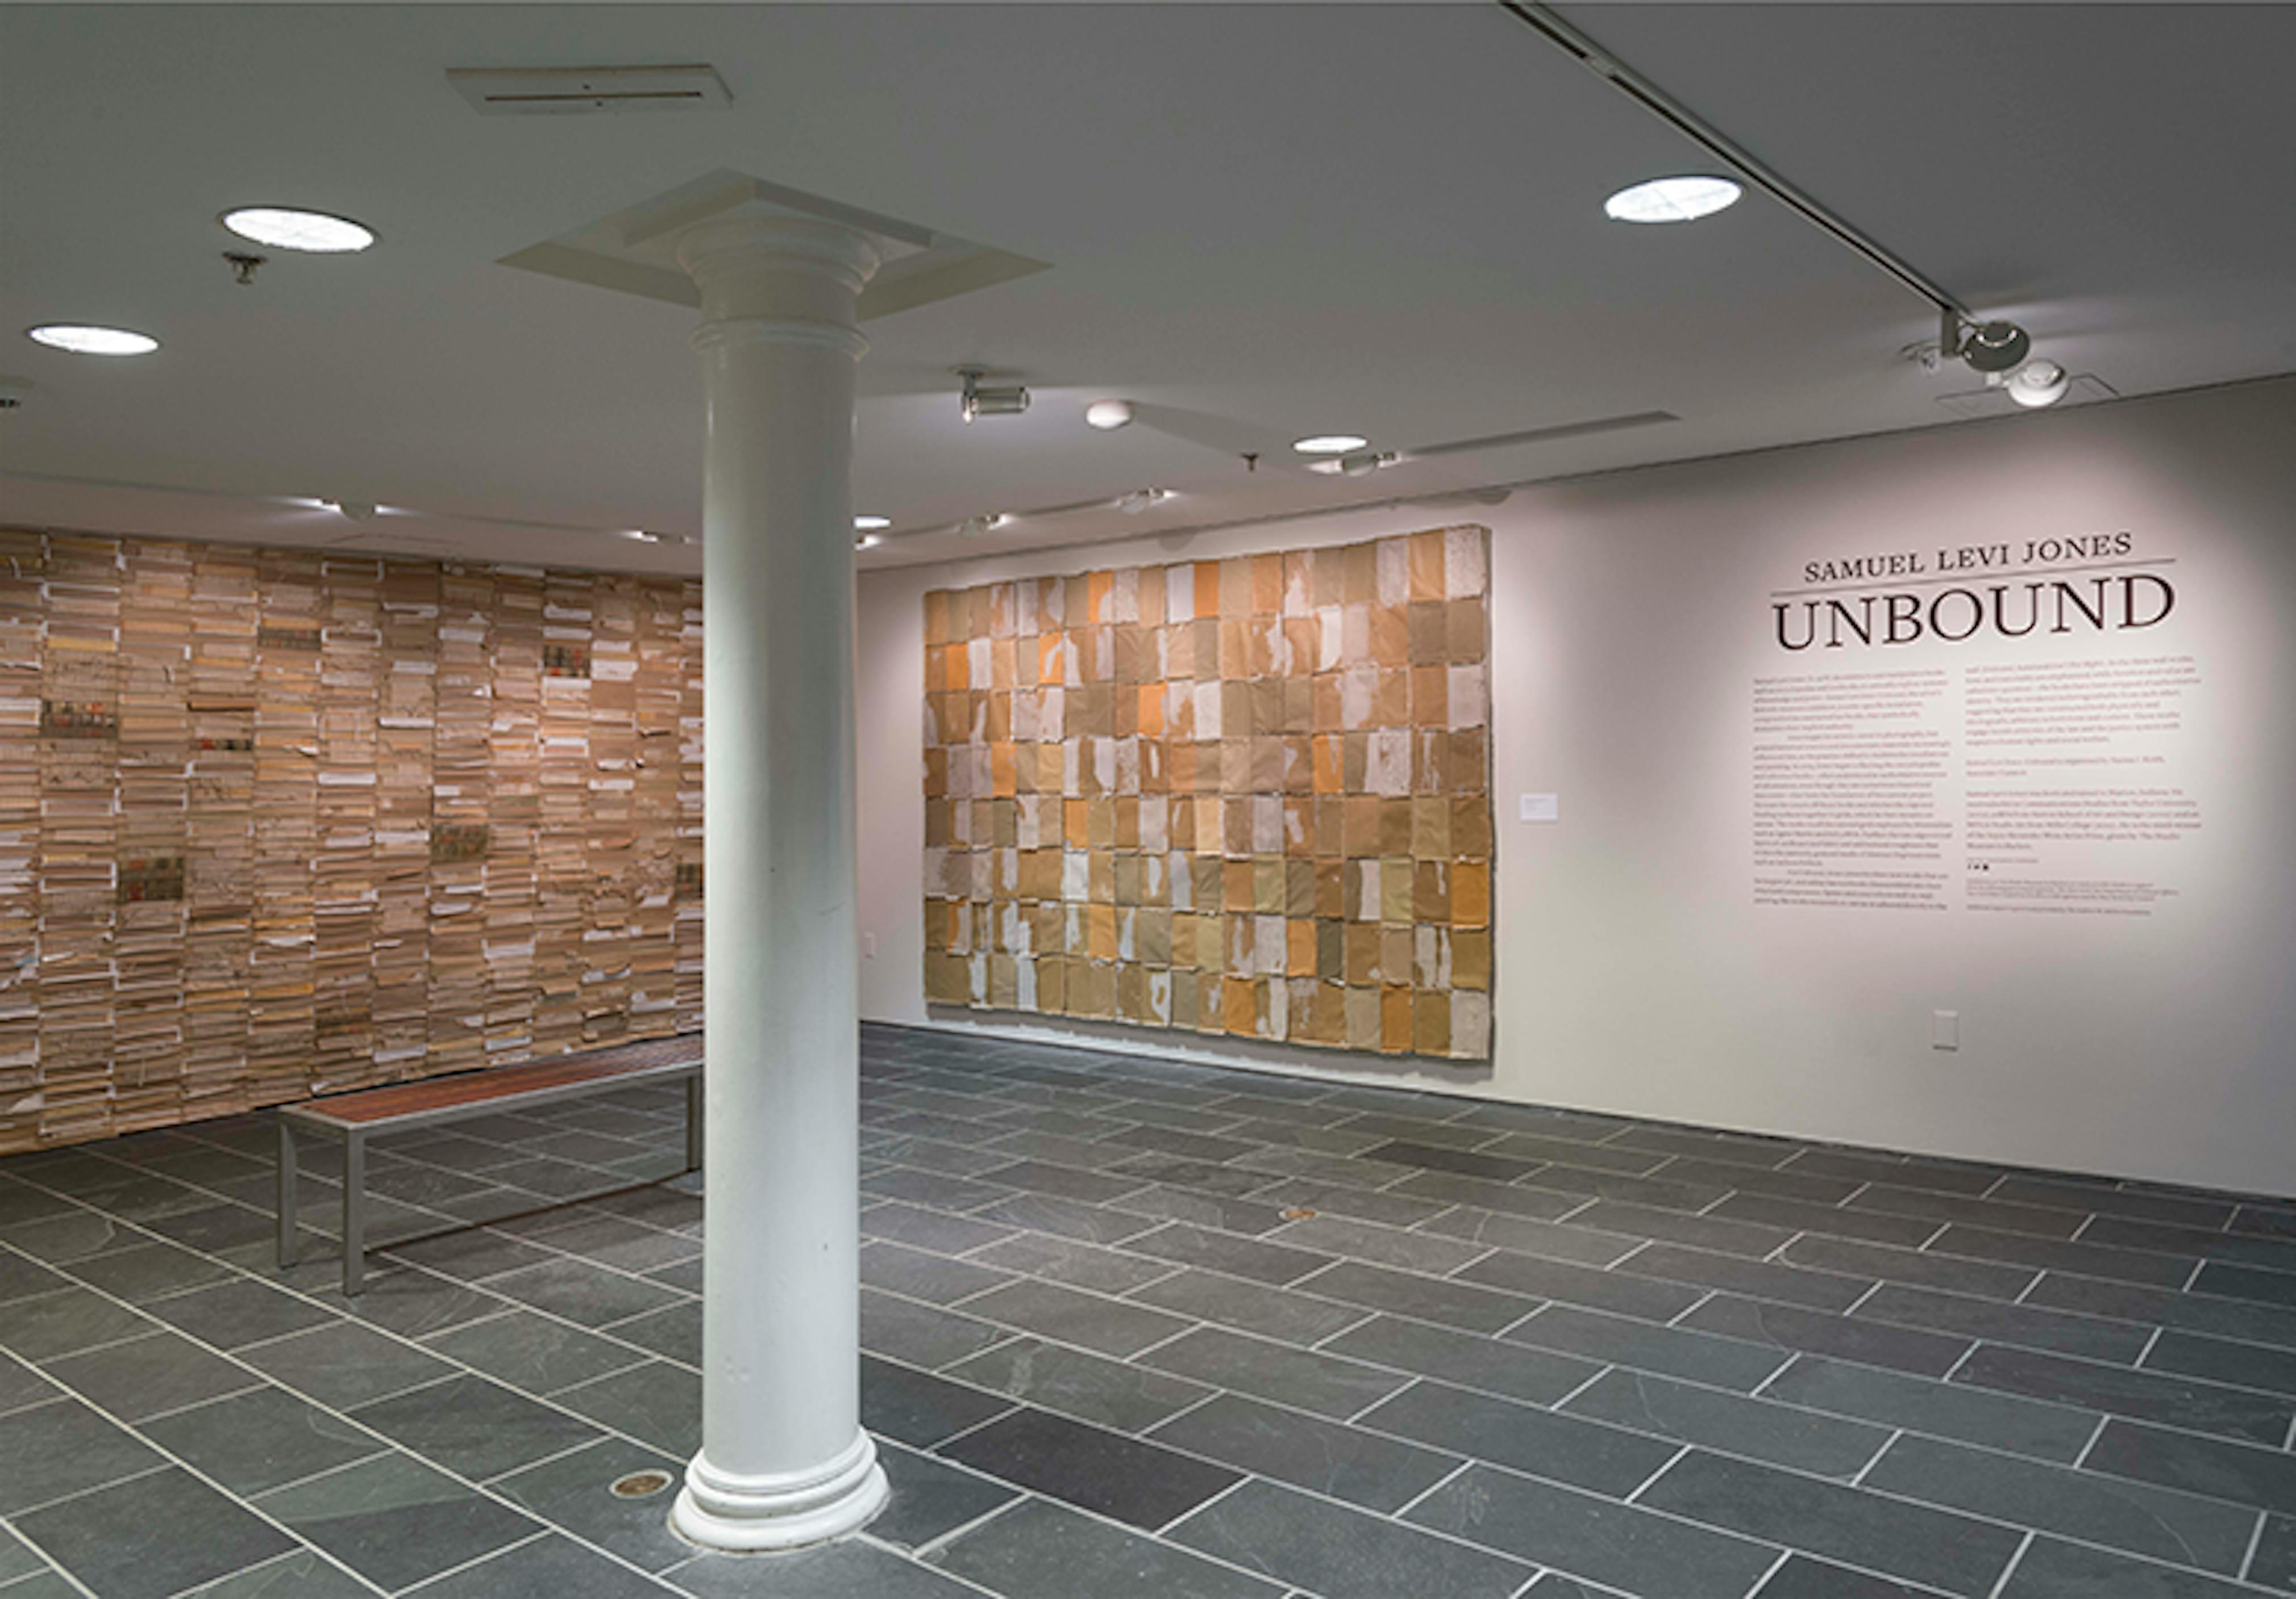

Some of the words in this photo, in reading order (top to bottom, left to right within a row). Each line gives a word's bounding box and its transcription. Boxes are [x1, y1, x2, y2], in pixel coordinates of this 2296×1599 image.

[1805, 553, 1925, 583] SAMUEL
[1938, 544, 2010, 571] LEVI
[2023, 532, 2132, 564] JONES
[1772, 574, 2176, 650] UNBOUND
